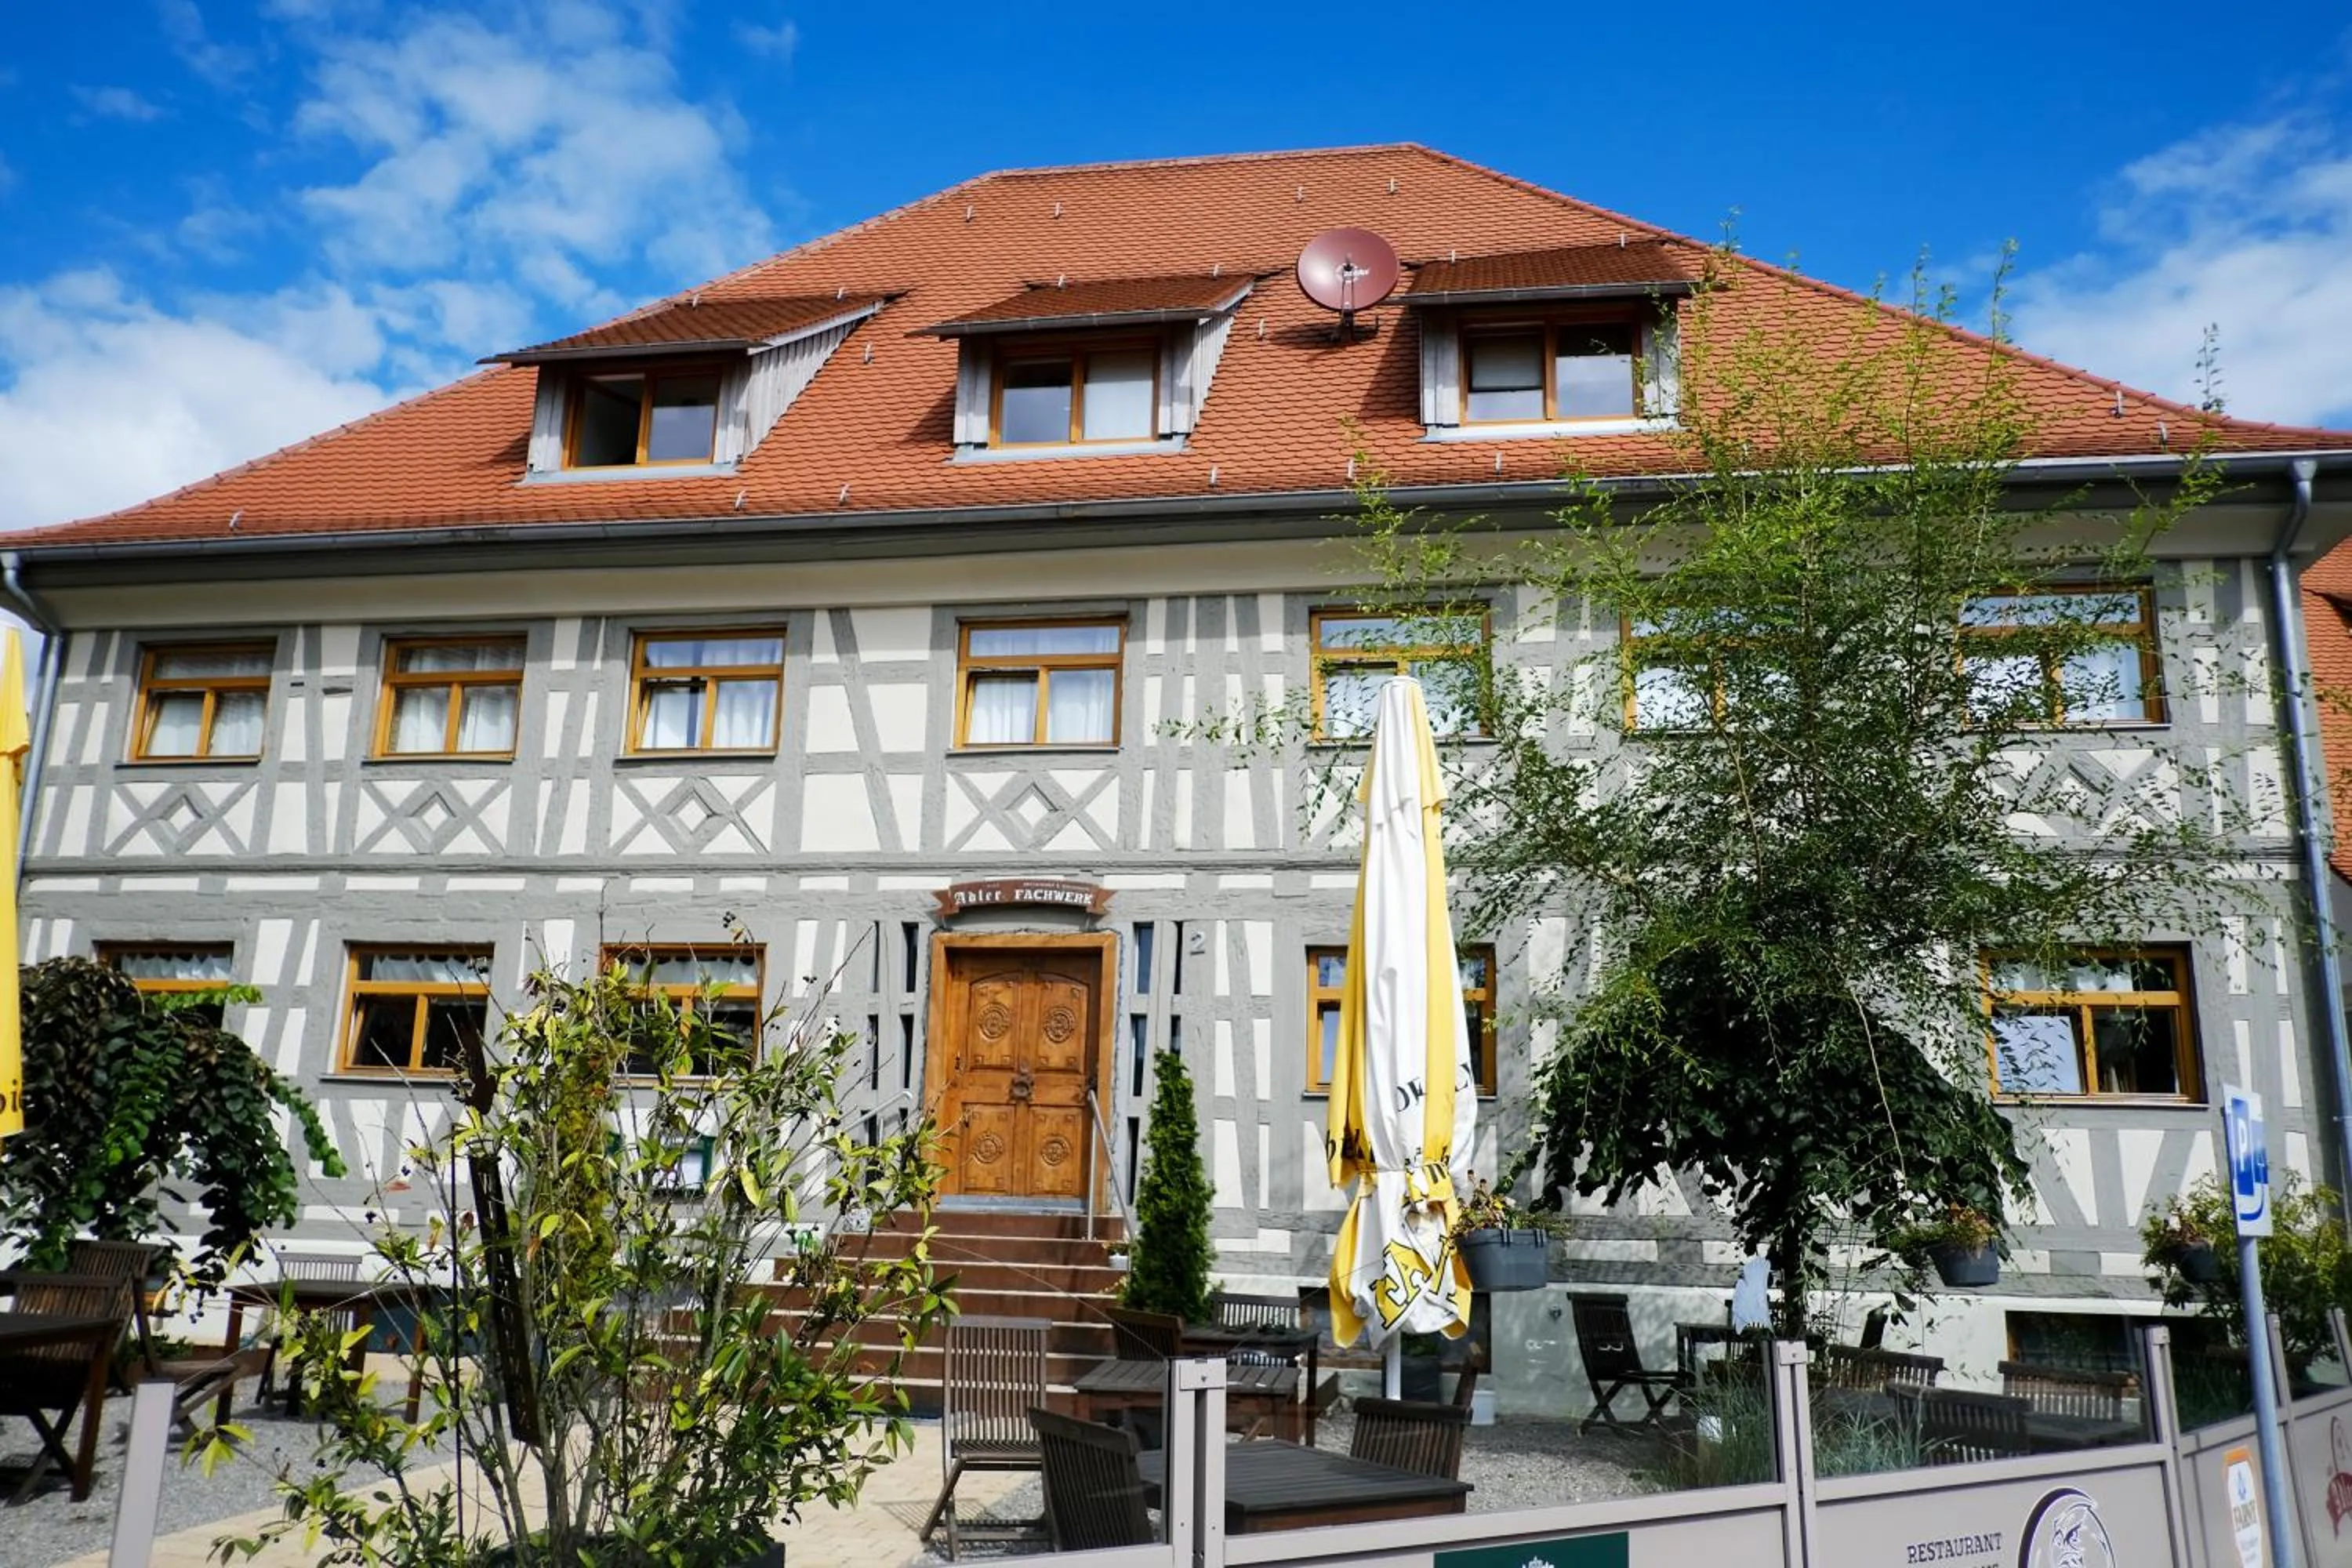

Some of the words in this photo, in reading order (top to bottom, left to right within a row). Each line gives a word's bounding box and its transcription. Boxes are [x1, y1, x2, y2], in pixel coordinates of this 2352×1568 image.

[1014, 888, 1094, 904] FACHWERK
[2238, 1117, 2248, 1172] P
[1906, 1532, 2002, 1564] RESTAURANT
